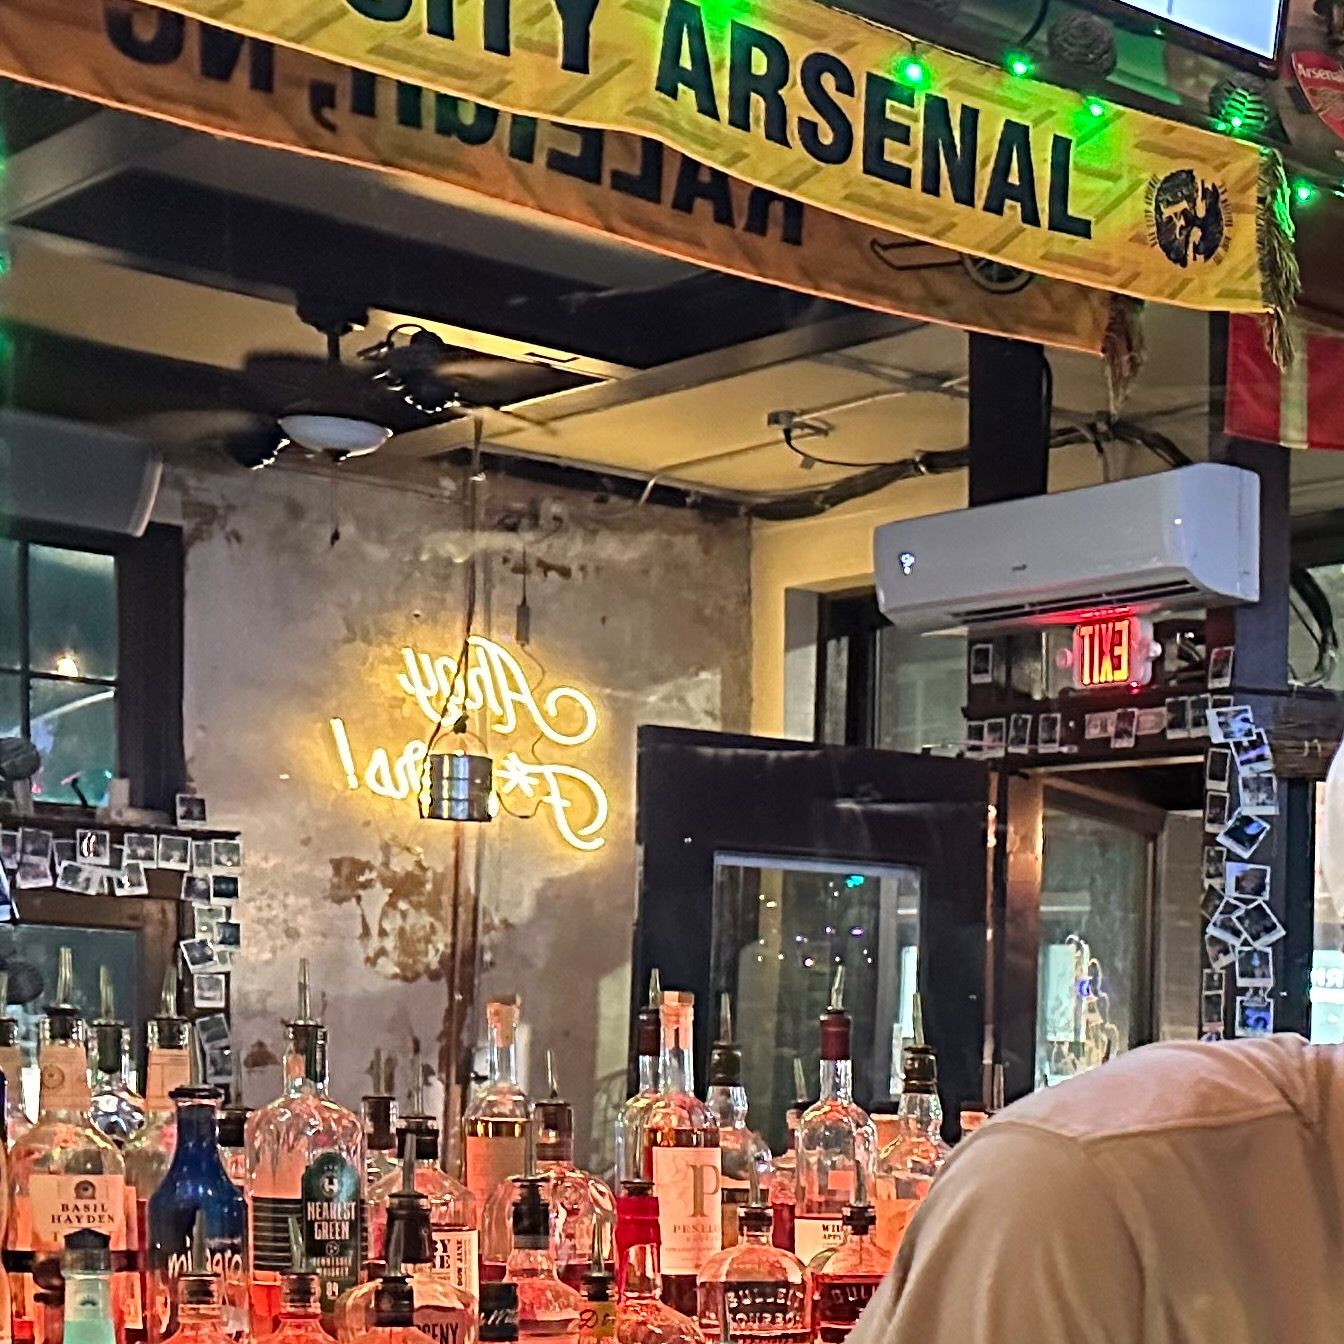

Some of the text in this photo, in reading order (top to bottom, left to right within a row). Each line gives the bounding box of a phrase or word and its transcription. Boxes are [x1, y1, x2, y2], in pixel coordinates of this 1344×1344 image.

[655, 0, 1093, 239] ARSENAL
[61, 1203, 108, 1214] BASIL
[307, 1201, 357, 1222] NEAREST
[50, 1213, 115, 1225] HAYDEN
[314, 1221, 350, 1241] GREEN
